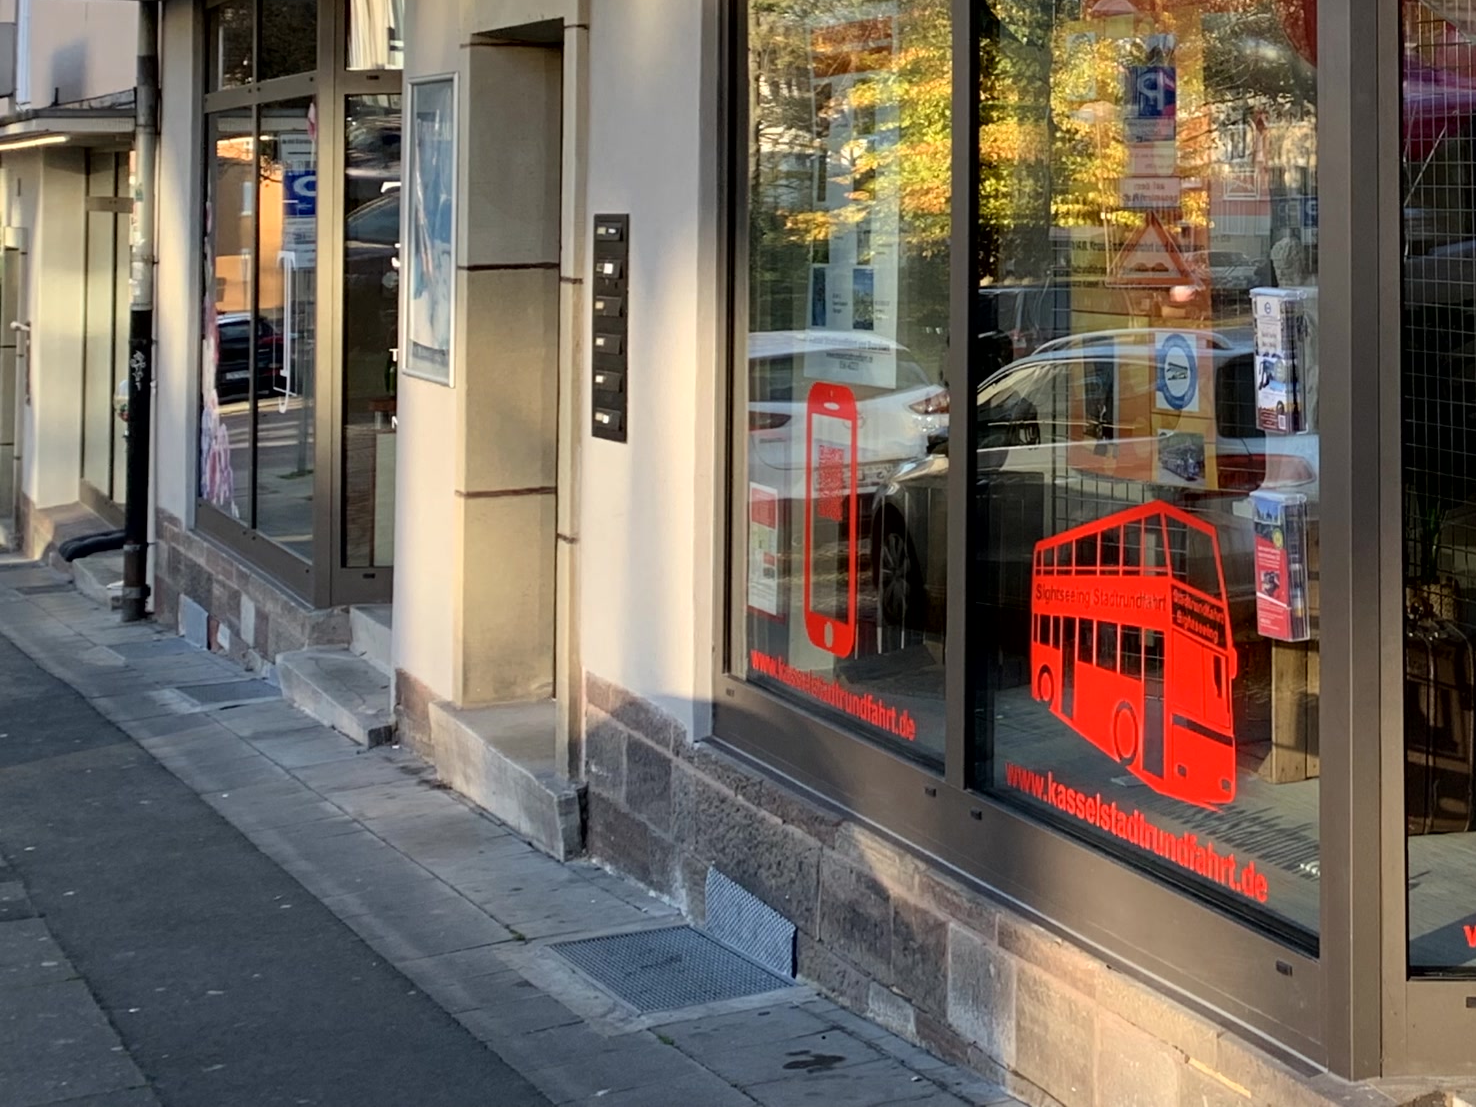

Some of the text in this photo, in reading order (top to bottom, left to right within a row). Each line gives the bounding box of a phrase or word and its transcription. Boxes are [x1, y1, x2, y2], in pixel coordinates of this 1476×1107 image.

[1035, 583, 1167, 612] Sightseeing Stadtrundfahrt
[750, 648, 918, 741] www.kasselstadtrundfahrt.de
[1005, 761, 1269, 904] www.kasselstadtrundfahrt.de
